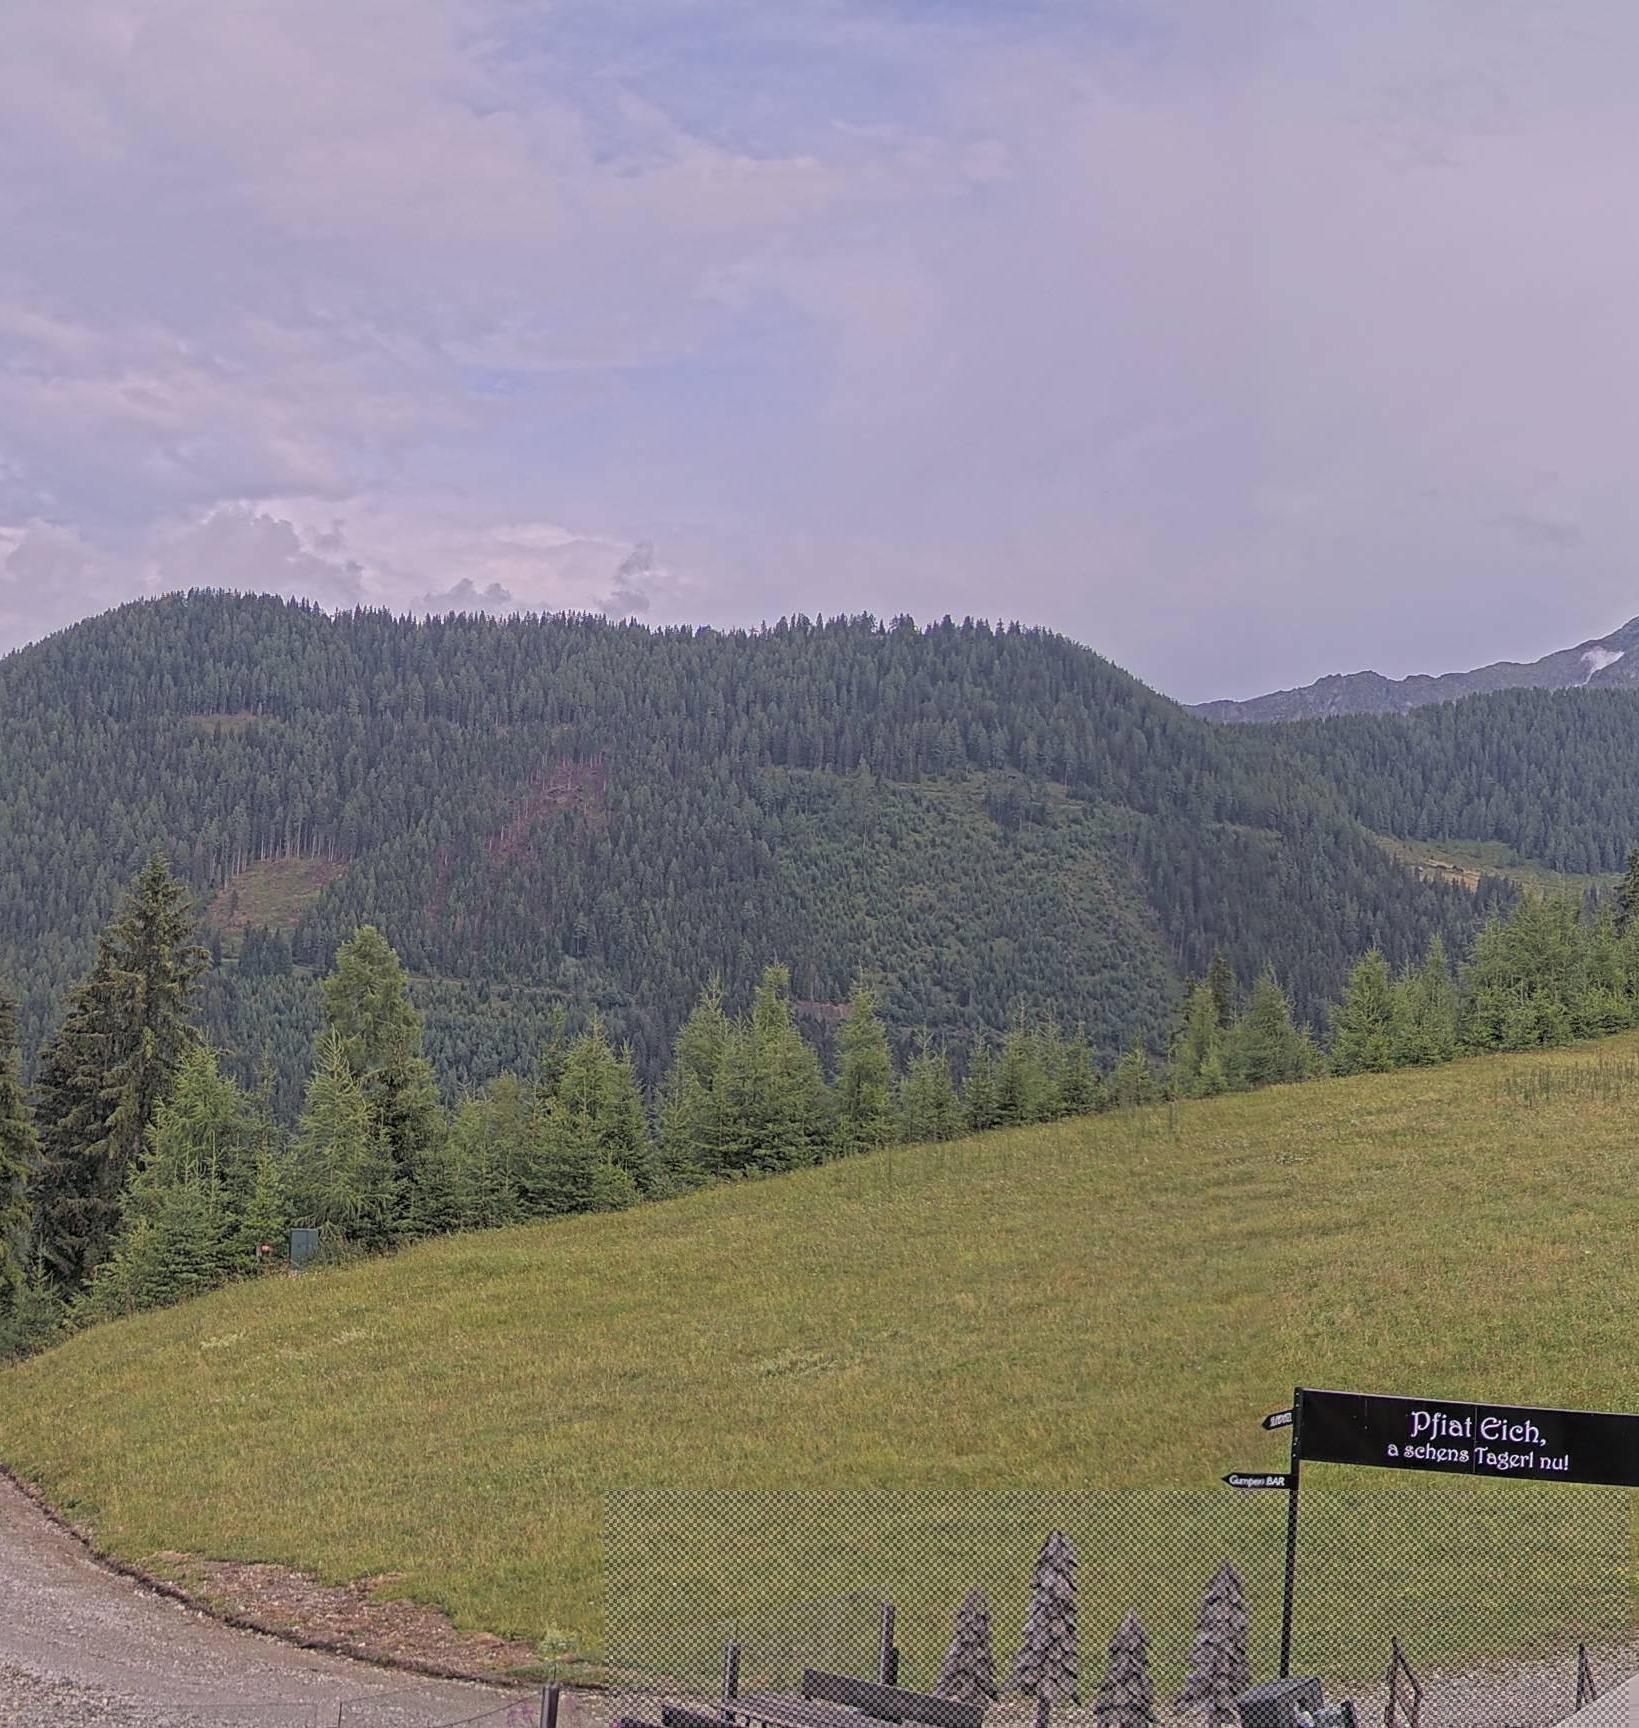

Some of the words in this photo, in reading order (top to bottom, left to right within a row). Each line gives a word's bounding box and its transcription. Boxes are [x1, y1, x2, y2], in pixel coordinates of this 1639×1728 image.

[1410, 1410, 1472, 1440] Pfiat
[1480, 1416, 1547, 1447] Eich,
[1387, 1443, 1399, 1457] a
[1403, 1443, 1470, 1463] schens
[1474, 1447, 1534, 1470] Tagerl
[1539, 1454, 1570, 1471] nu!
[1265, 1476, 1285, 1486] BAR
